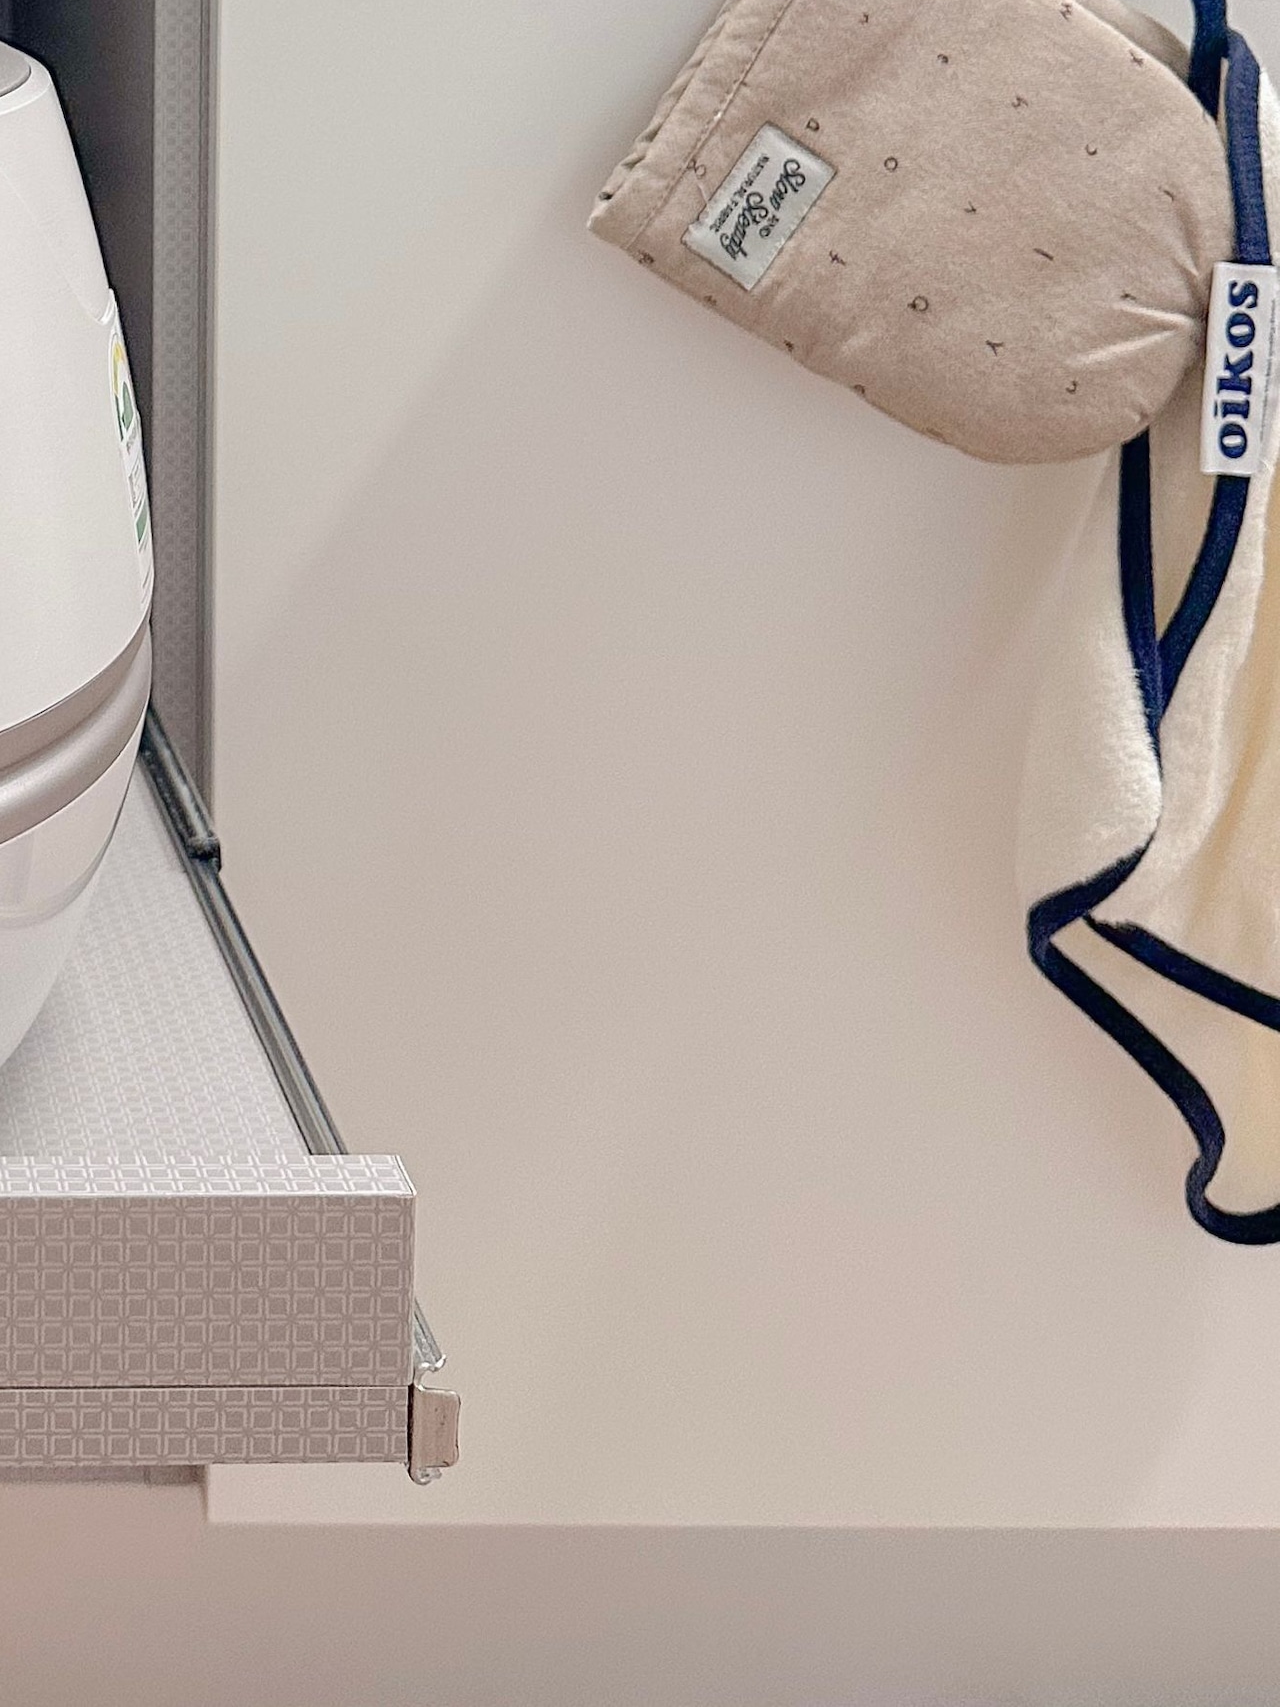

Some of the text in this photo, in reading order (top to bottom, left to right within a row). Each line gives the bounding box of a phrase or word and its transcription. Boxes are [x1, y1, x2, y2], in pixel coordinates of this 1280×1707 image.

[769, 158, 806, 211] Slow
[719, 191, 770, 261] Steady
[1214, 279, 1259, 460] oikos
